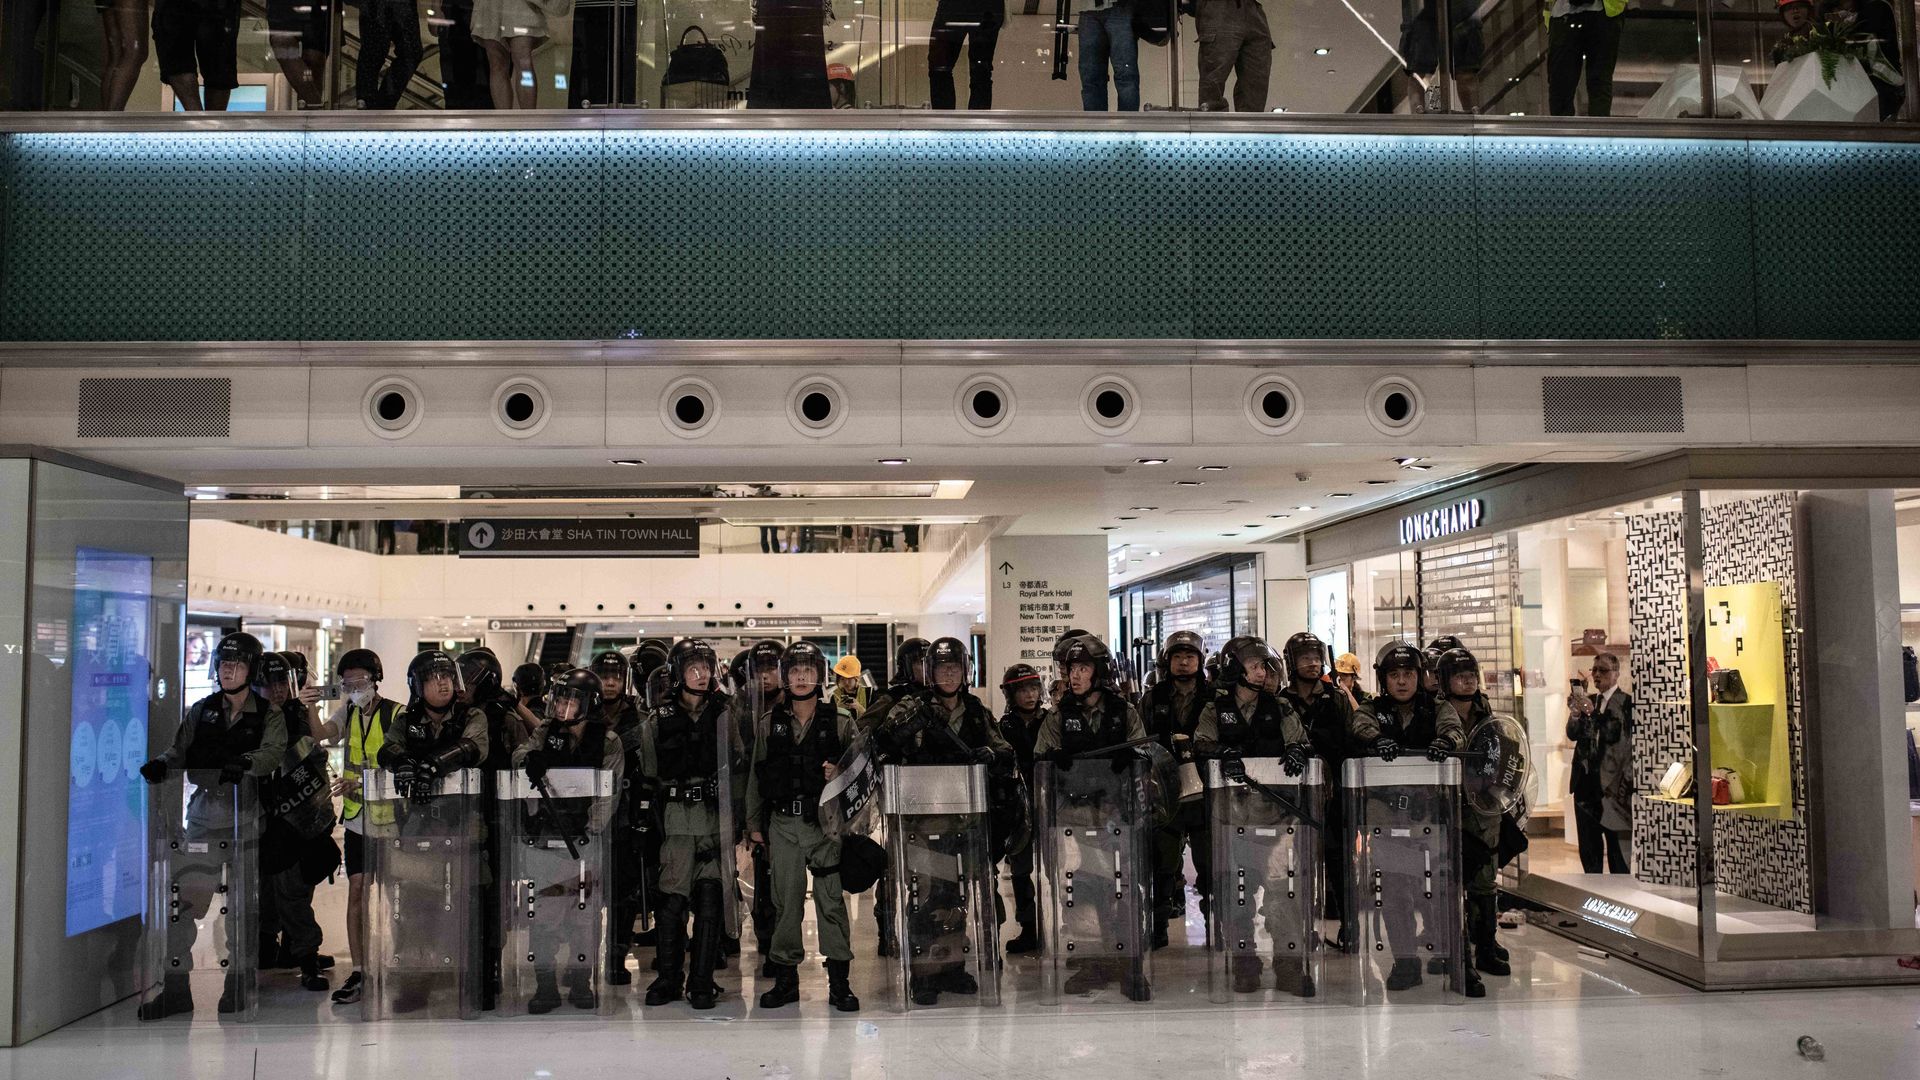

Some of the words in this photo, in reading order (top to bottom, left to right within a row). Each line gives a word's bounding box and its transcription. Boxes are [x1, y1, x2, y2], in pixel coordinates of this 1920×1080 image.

[501, 528, 563, 540] 沙田大會堂
[568, 529, 592, 540] SHA
[596, 529, 616, 540] TIN
[620, 529, 658, 540] TOWN
[662, 529, 692, 540] HALL
[1400, 498, 1480, 545] LONGCHAMP
[1503, 754, 1519, 787] POLICE
[1582, 897, 1638, 923] LONGCHAMP
